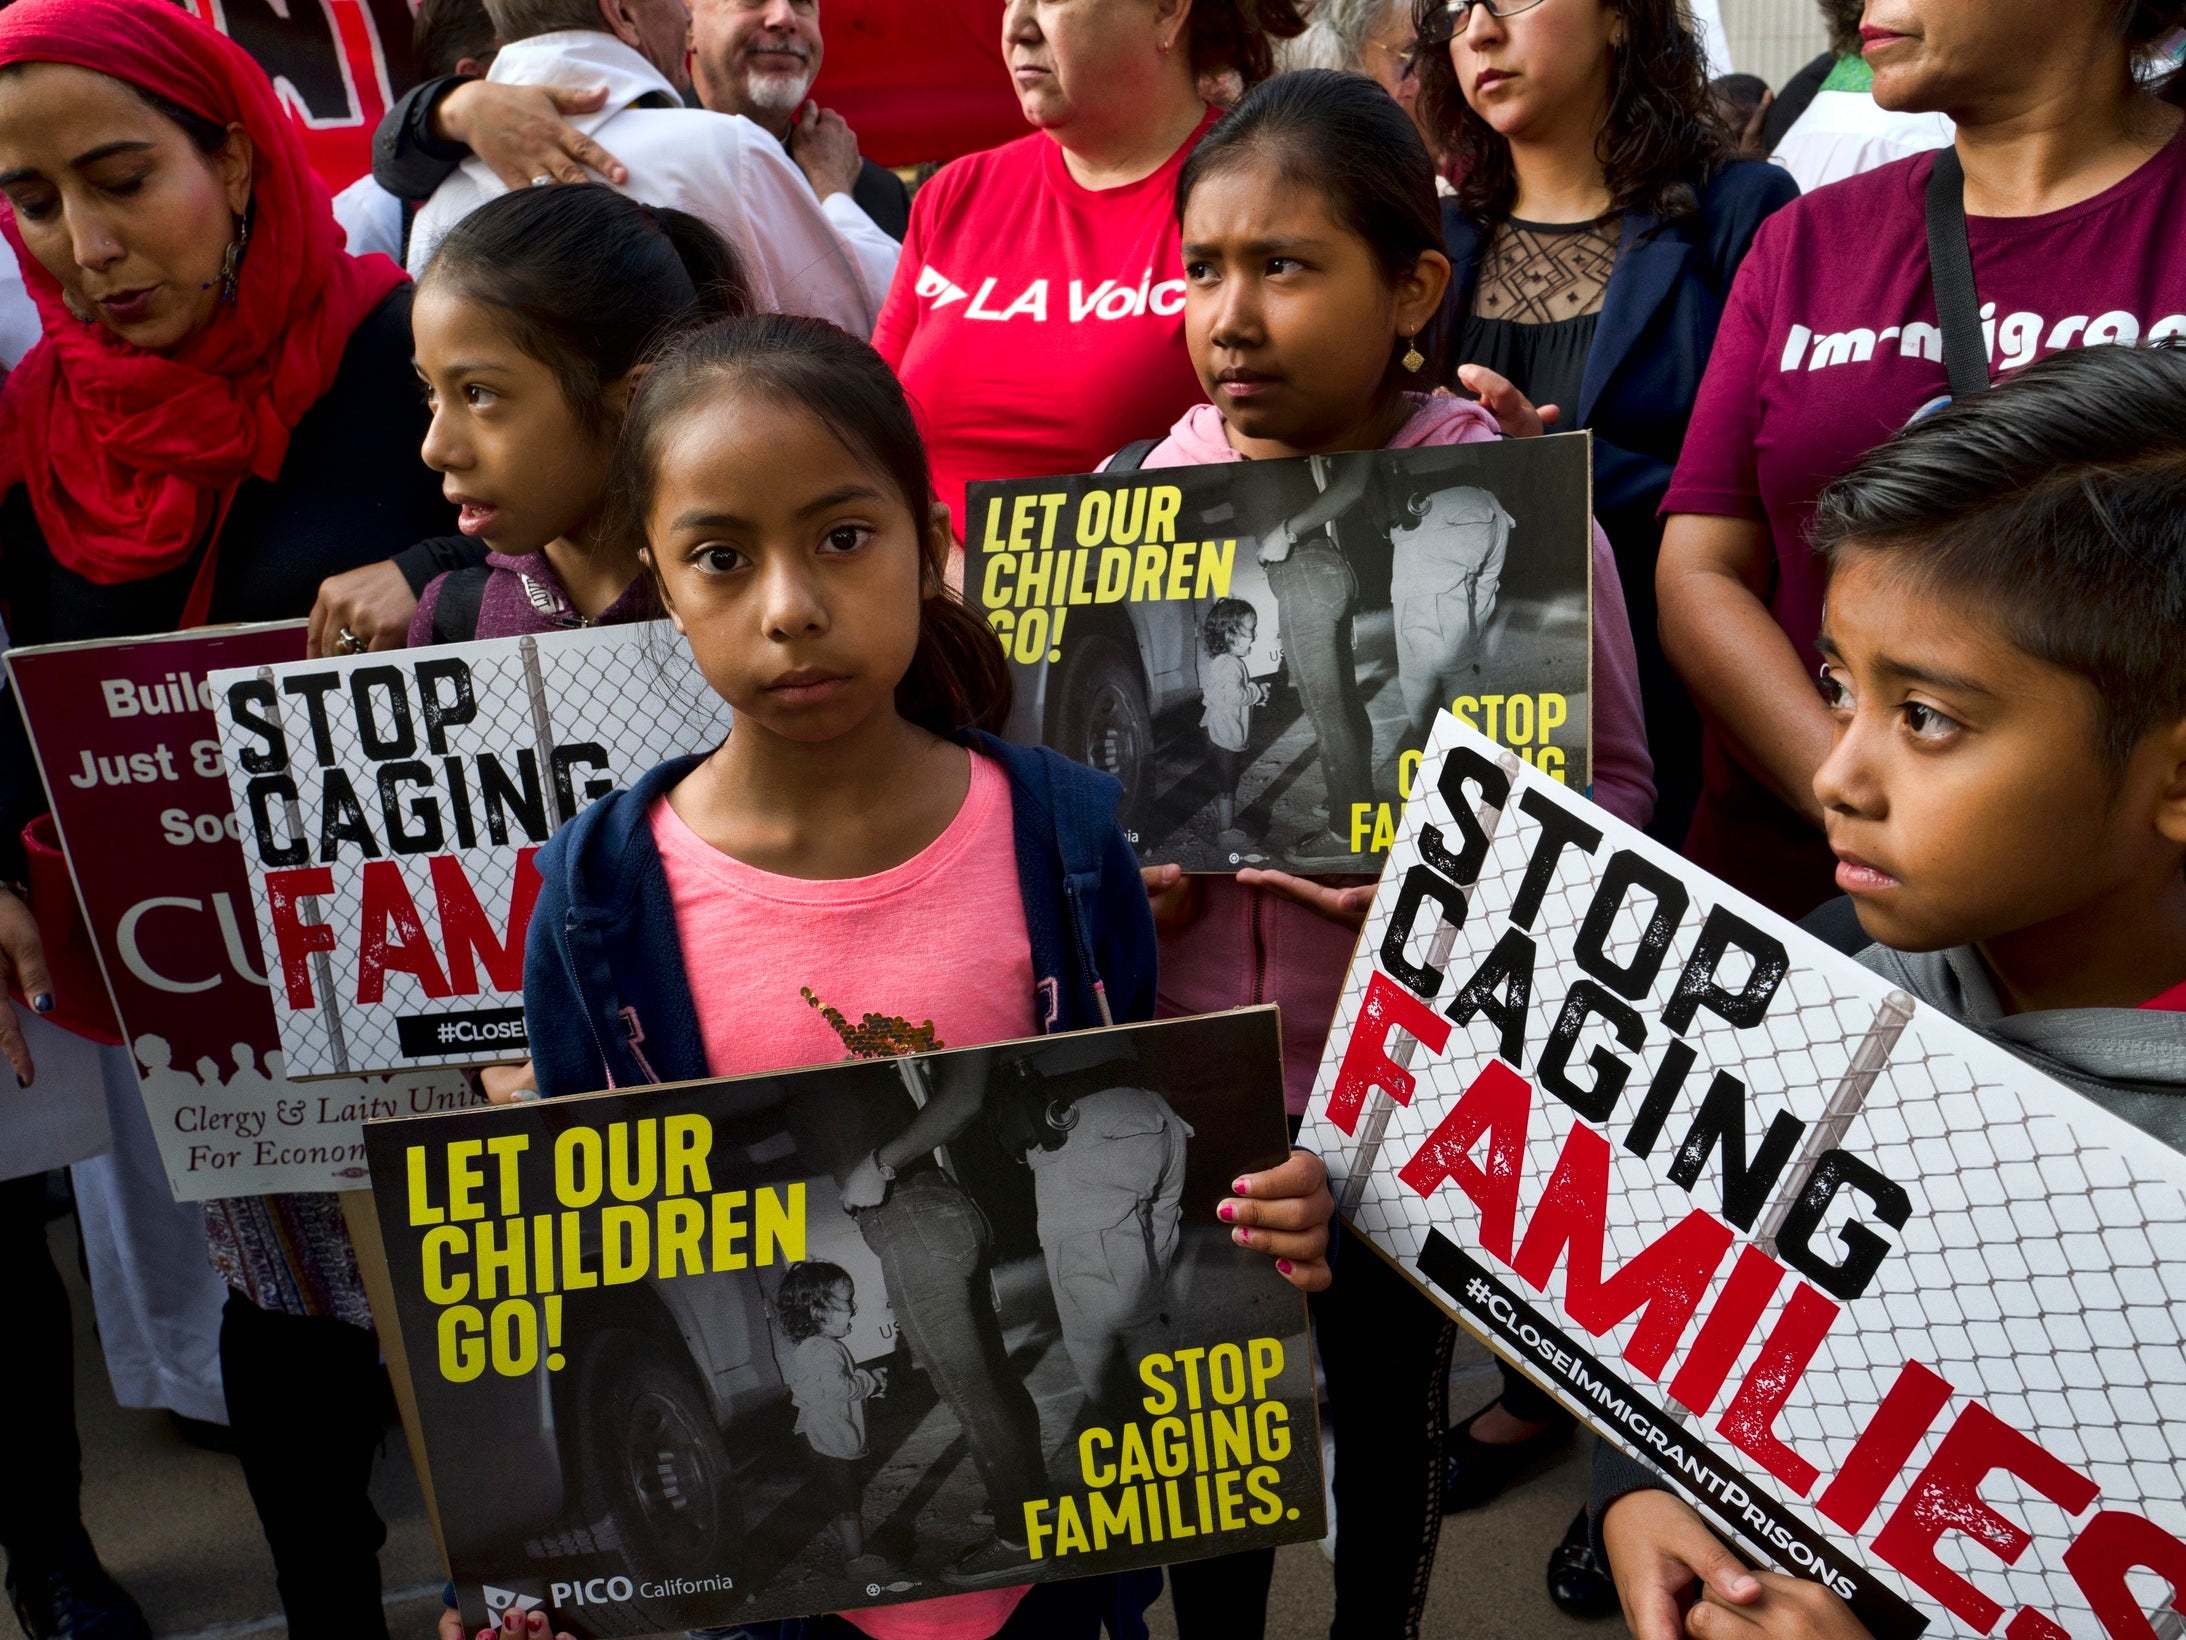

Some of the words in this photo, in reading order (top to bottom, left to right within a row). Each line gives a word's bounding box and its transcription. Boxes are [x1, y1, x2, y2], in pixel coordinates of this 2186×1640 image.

[963, 277, 1049, 323] LA
[982, 493, 1068, 553] LET
[1075, 485, 1183, 548] OUR
[982, 539, 1237, 609] CHILDREN
[227, 656, 478, 775] STOP
[1451, 693, 1567, 745] STOP
[69, 743, 180, 789] Just
[189, 739, 226, 778] &
[245, 741, 613, 868] CAGING
[1417, 745, 1790, 1038] STOP
[174, 1105, 267, 1137] Clergy
[276, 1099, 306, 1126] &
[1379, 863, 1914, 1301] CAGING
[187, 1144, 242, 1173] For
[406, 1134, 529, 1227] LET
[554, 1113, 713, 1209] OUR
[421, 1182, 808, 1306] CHILDREN
[437, 1294, 567, 1384] GO!
[1138, 1337, 1286, 1416] STOP
[1078, 1400, 1293, 1489] CAGING
[1023, 1465, 1301, 1561] FAMILIES.
[551, 1575, 633, 1609] PICO
[640, 1574, 734, 1599] California
